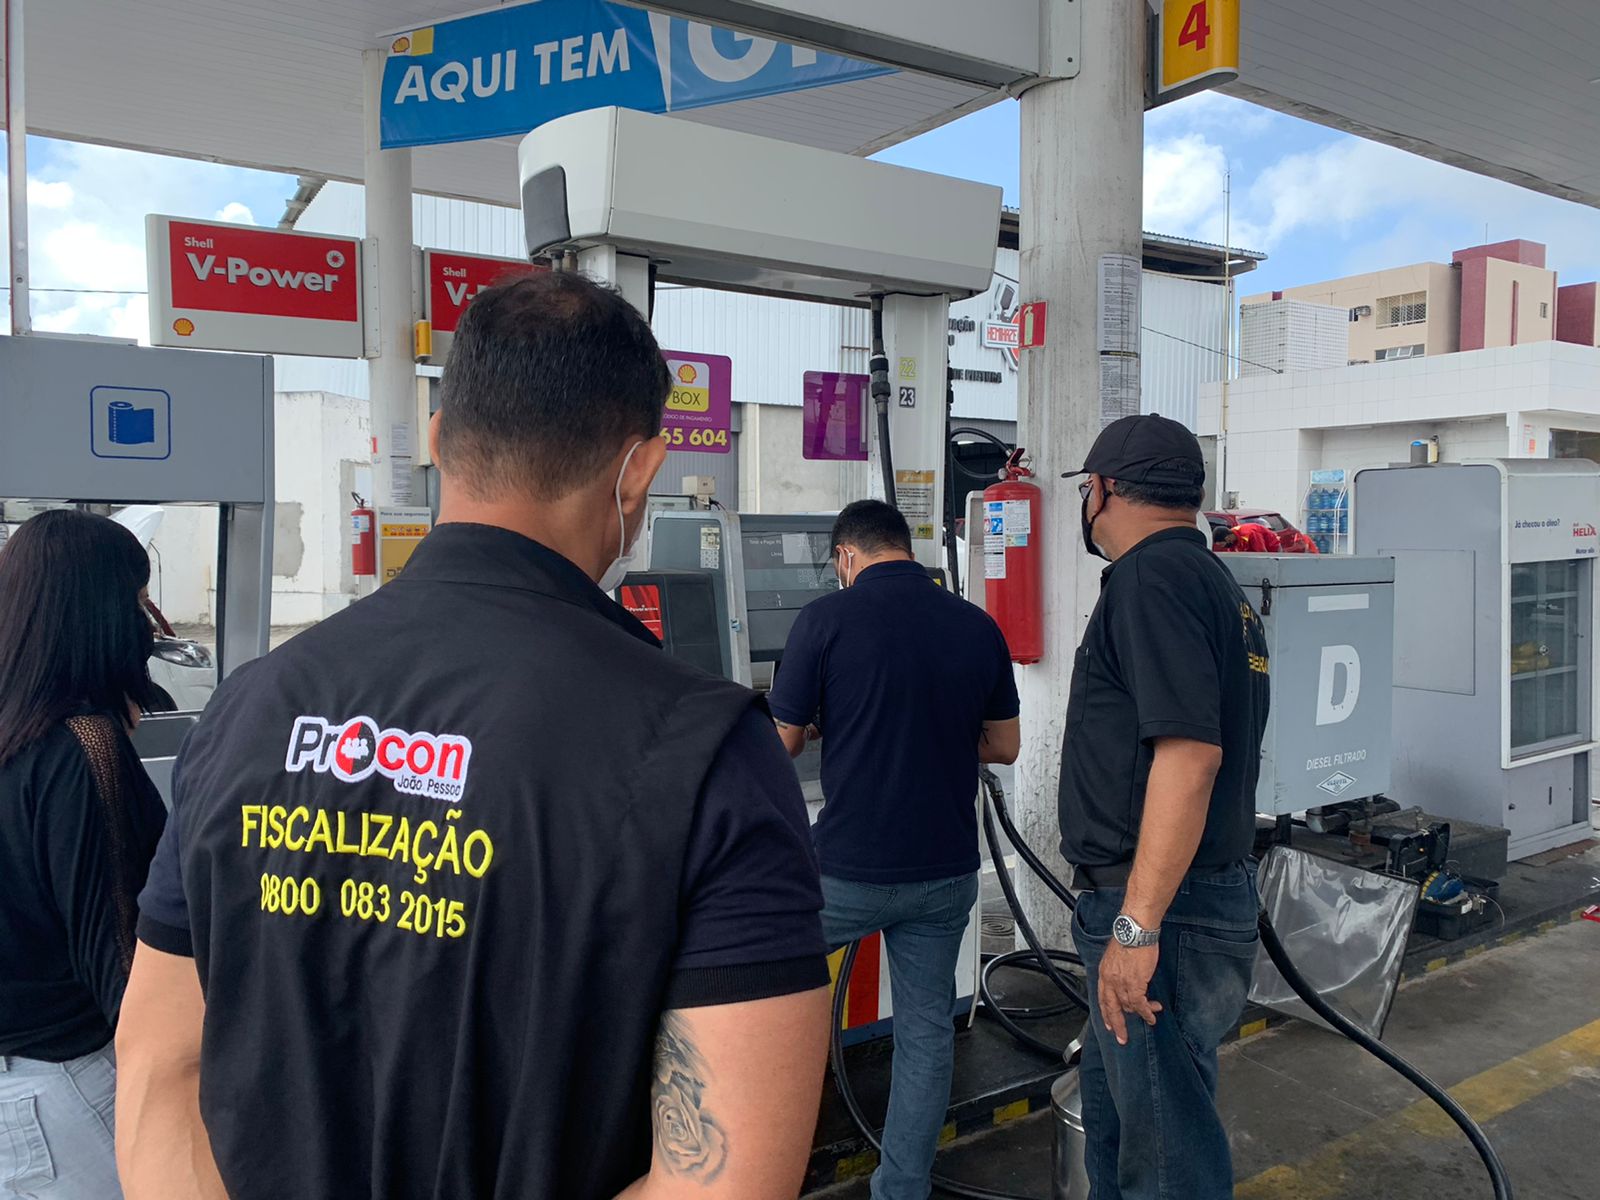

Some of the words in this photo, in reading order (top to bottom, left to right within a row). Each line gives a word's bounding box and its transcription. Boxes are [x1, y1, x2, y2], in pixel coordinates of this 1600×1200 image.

[1178, 0, 1210, 51] 4
[394, 49, 517, 104] AQUI
[533, 28, 631, 86] TEM
[183, 236, 214, 249] Shell
[185, 252, 339, 292] V-Power
[442, 266, 467, 278] Shell
[900, 359, 916, 378] 22
[672, 390, 701, 406] BOX
[900, 388, 915, 406] 23
[689, 428, 728, 447] 604
[1573, 527, 1596, 537] HELIX
[1315, 644, 1361, 726] D
[291, 720, 465, 781] Procon
[1306, 756, 1333, 771] DIESEL
[1333, 749, 1367, 766] FILTRADO
[397, 774, 423, 791] João
[241, 804, 494, 884] FISCALIZAÇÃO
[260, 872, 321, 916] 0800
[340, 878, 391, 923] 083
[396, 890, 467, 938] 2015
